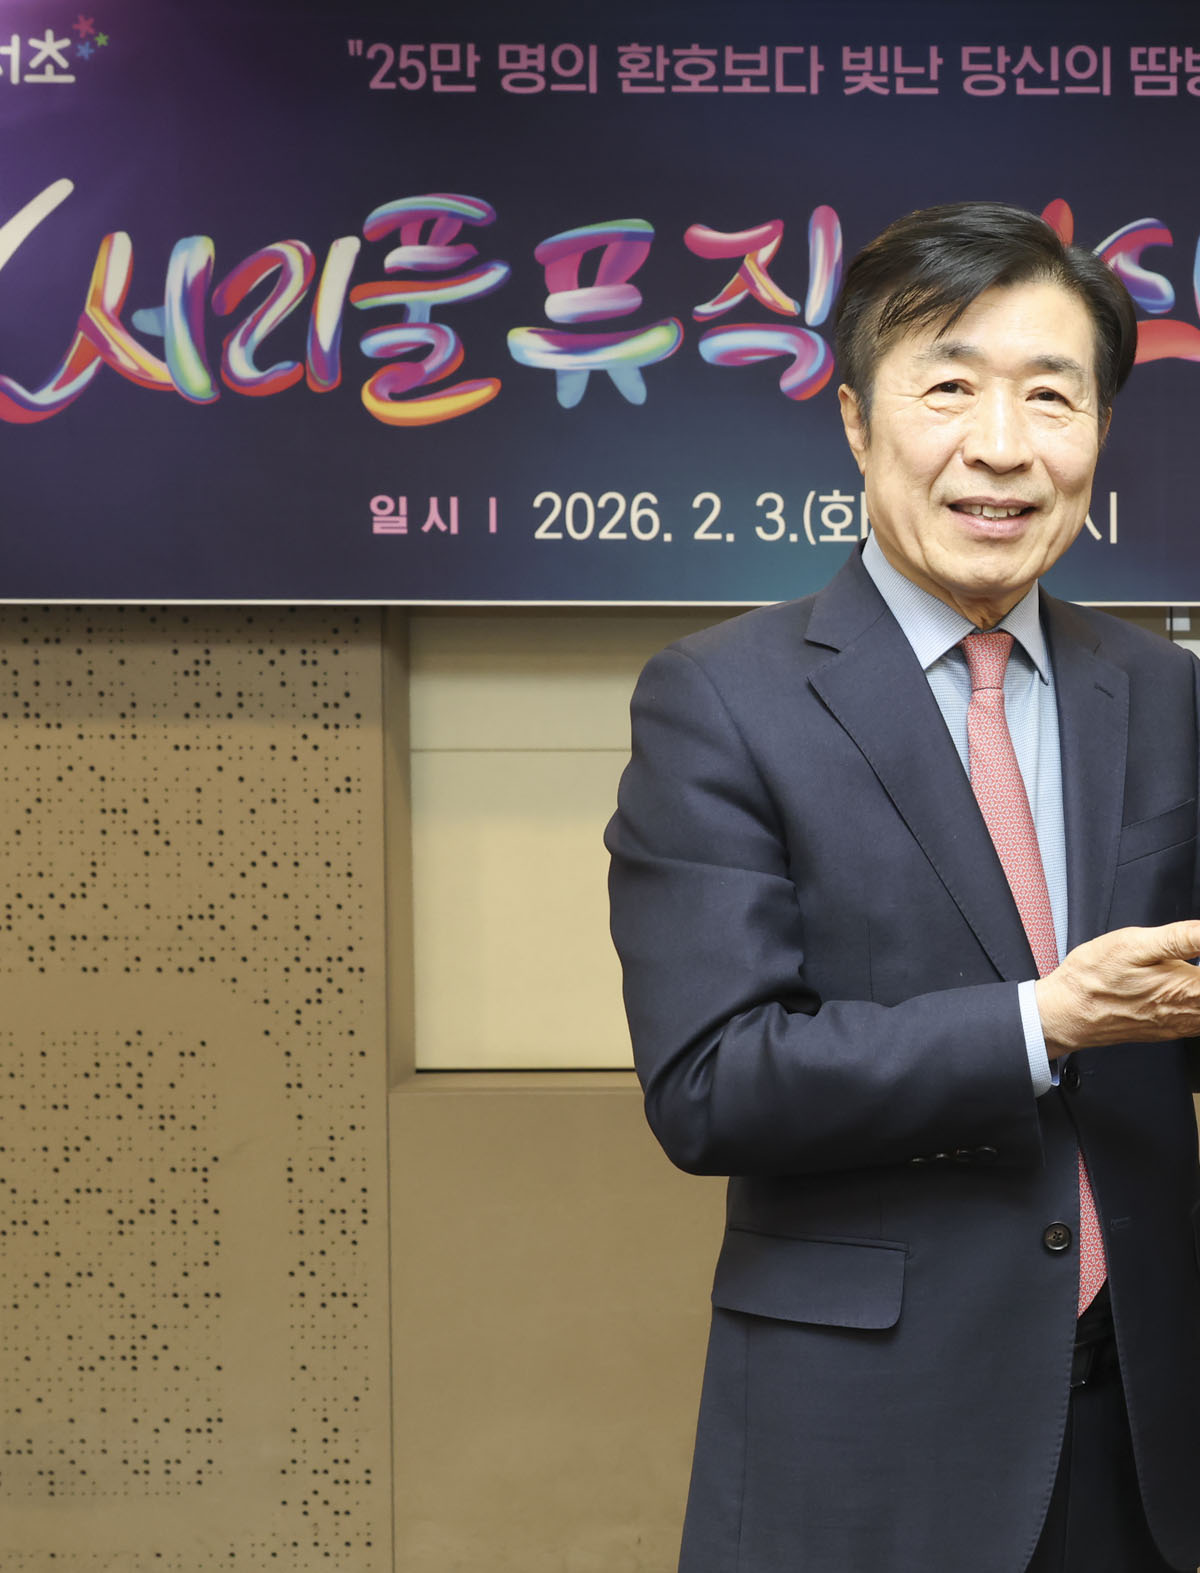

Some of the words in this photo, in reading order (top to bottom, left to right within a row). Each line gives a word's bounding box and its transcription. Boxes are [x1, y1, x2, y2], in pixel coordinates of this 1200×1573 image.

[347, 39, 481, 93] "25만
[498, 43, 598, 94] 명의
[617, 43, 825, 94] 환호보다
[841, 44, 943, 96] 빛난
[961, 44, 1111, 96] 당신의
[532, 491, 673, 543] 2026.
[691, 491, 735, 542] 2.
